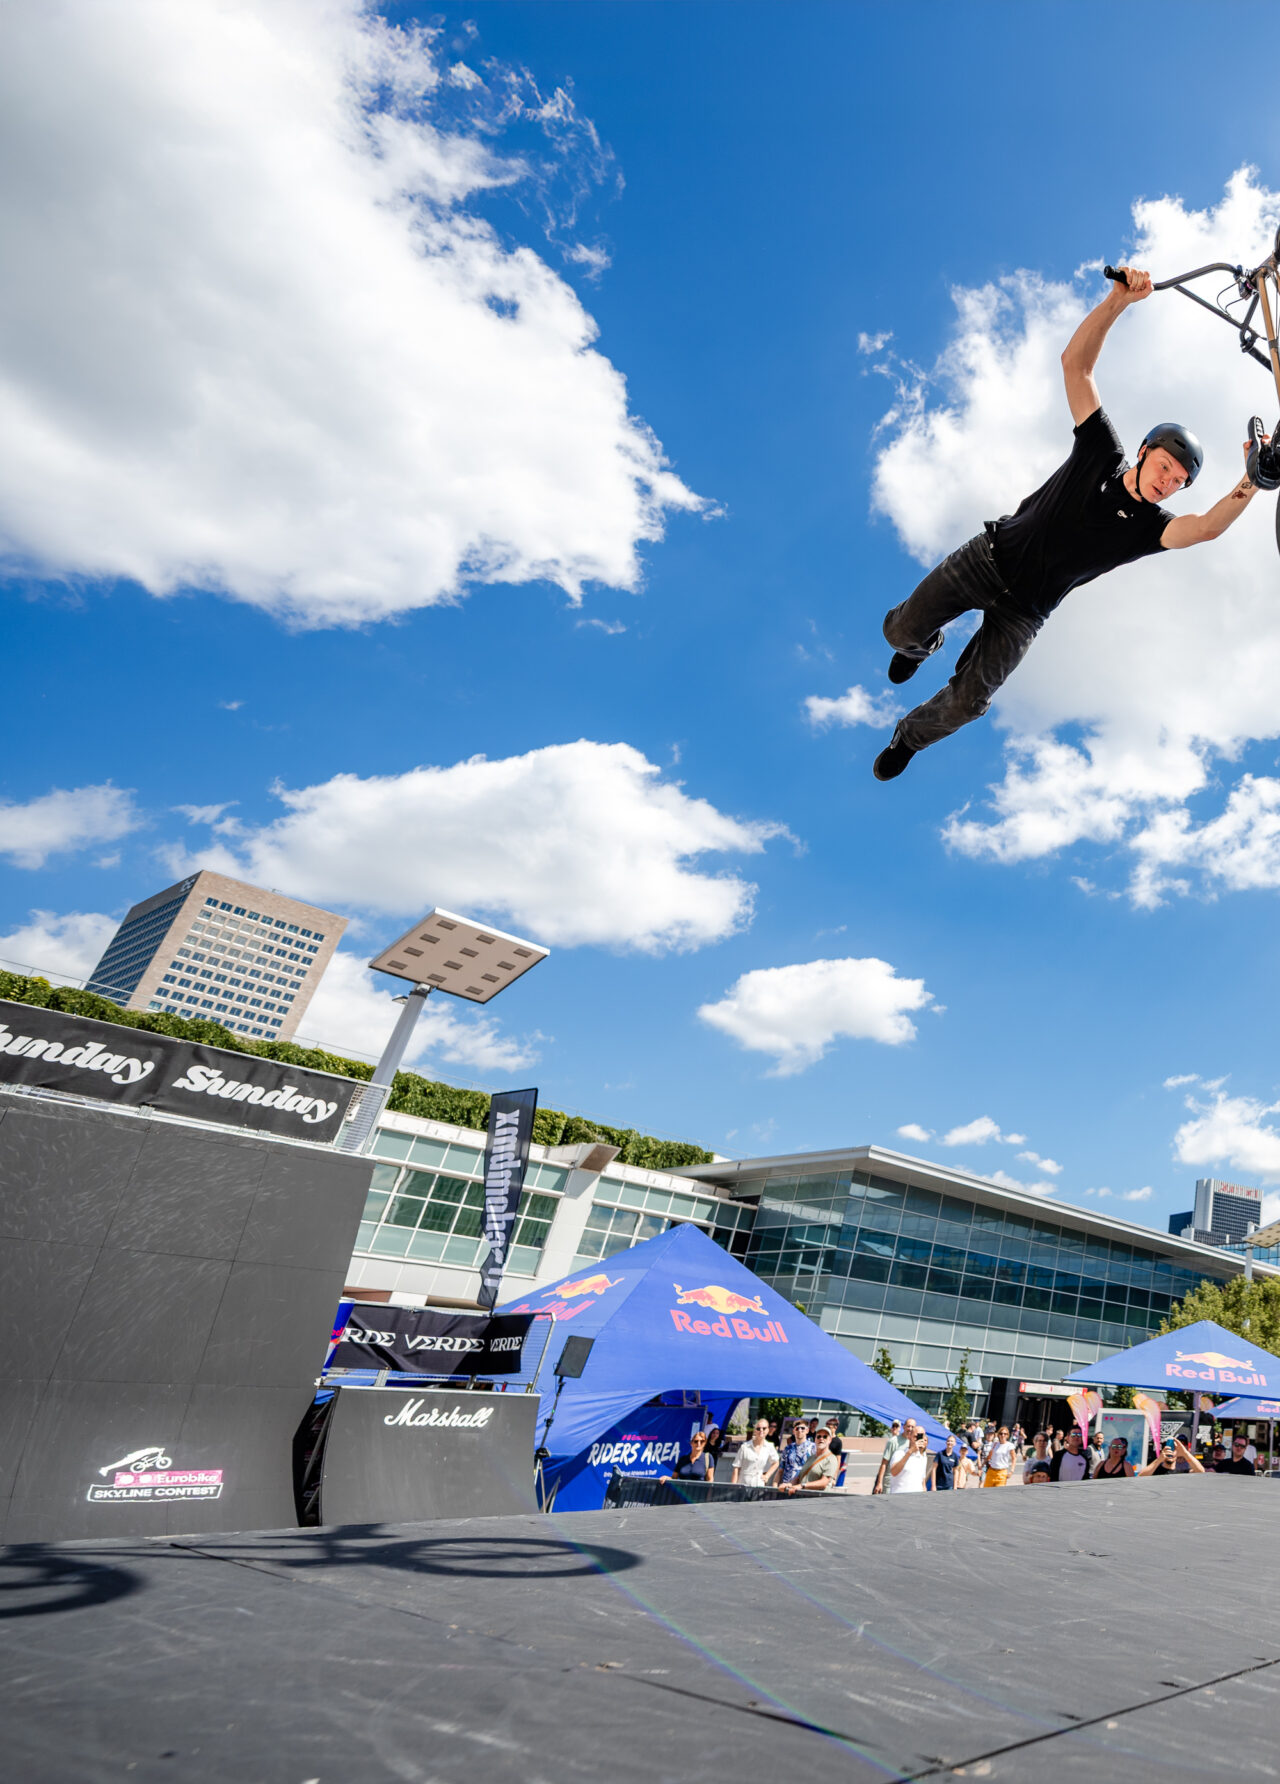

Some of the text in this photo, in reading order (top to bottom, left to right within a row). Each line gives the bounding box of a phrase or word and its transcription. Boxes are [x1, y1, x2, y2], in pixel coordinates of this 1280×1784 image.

[0, 1024, 339, 1124] unday Sunday
[670, 1309, 789, 1344] Red Bull
[405, 1333, 485, 1353] VERDE
[1165, 1363, 1268, 1387] Red Bull
[384, 1398, 495, 1429] Marshall
[1257, 1405, 1280, 1414] Red
[587, 1441, 681, 1468] RIDERS AREA
[157, 1474, 218, 1484] Eurobike
[94, 1486, 217, 1499] SKYLINE CONTEST
